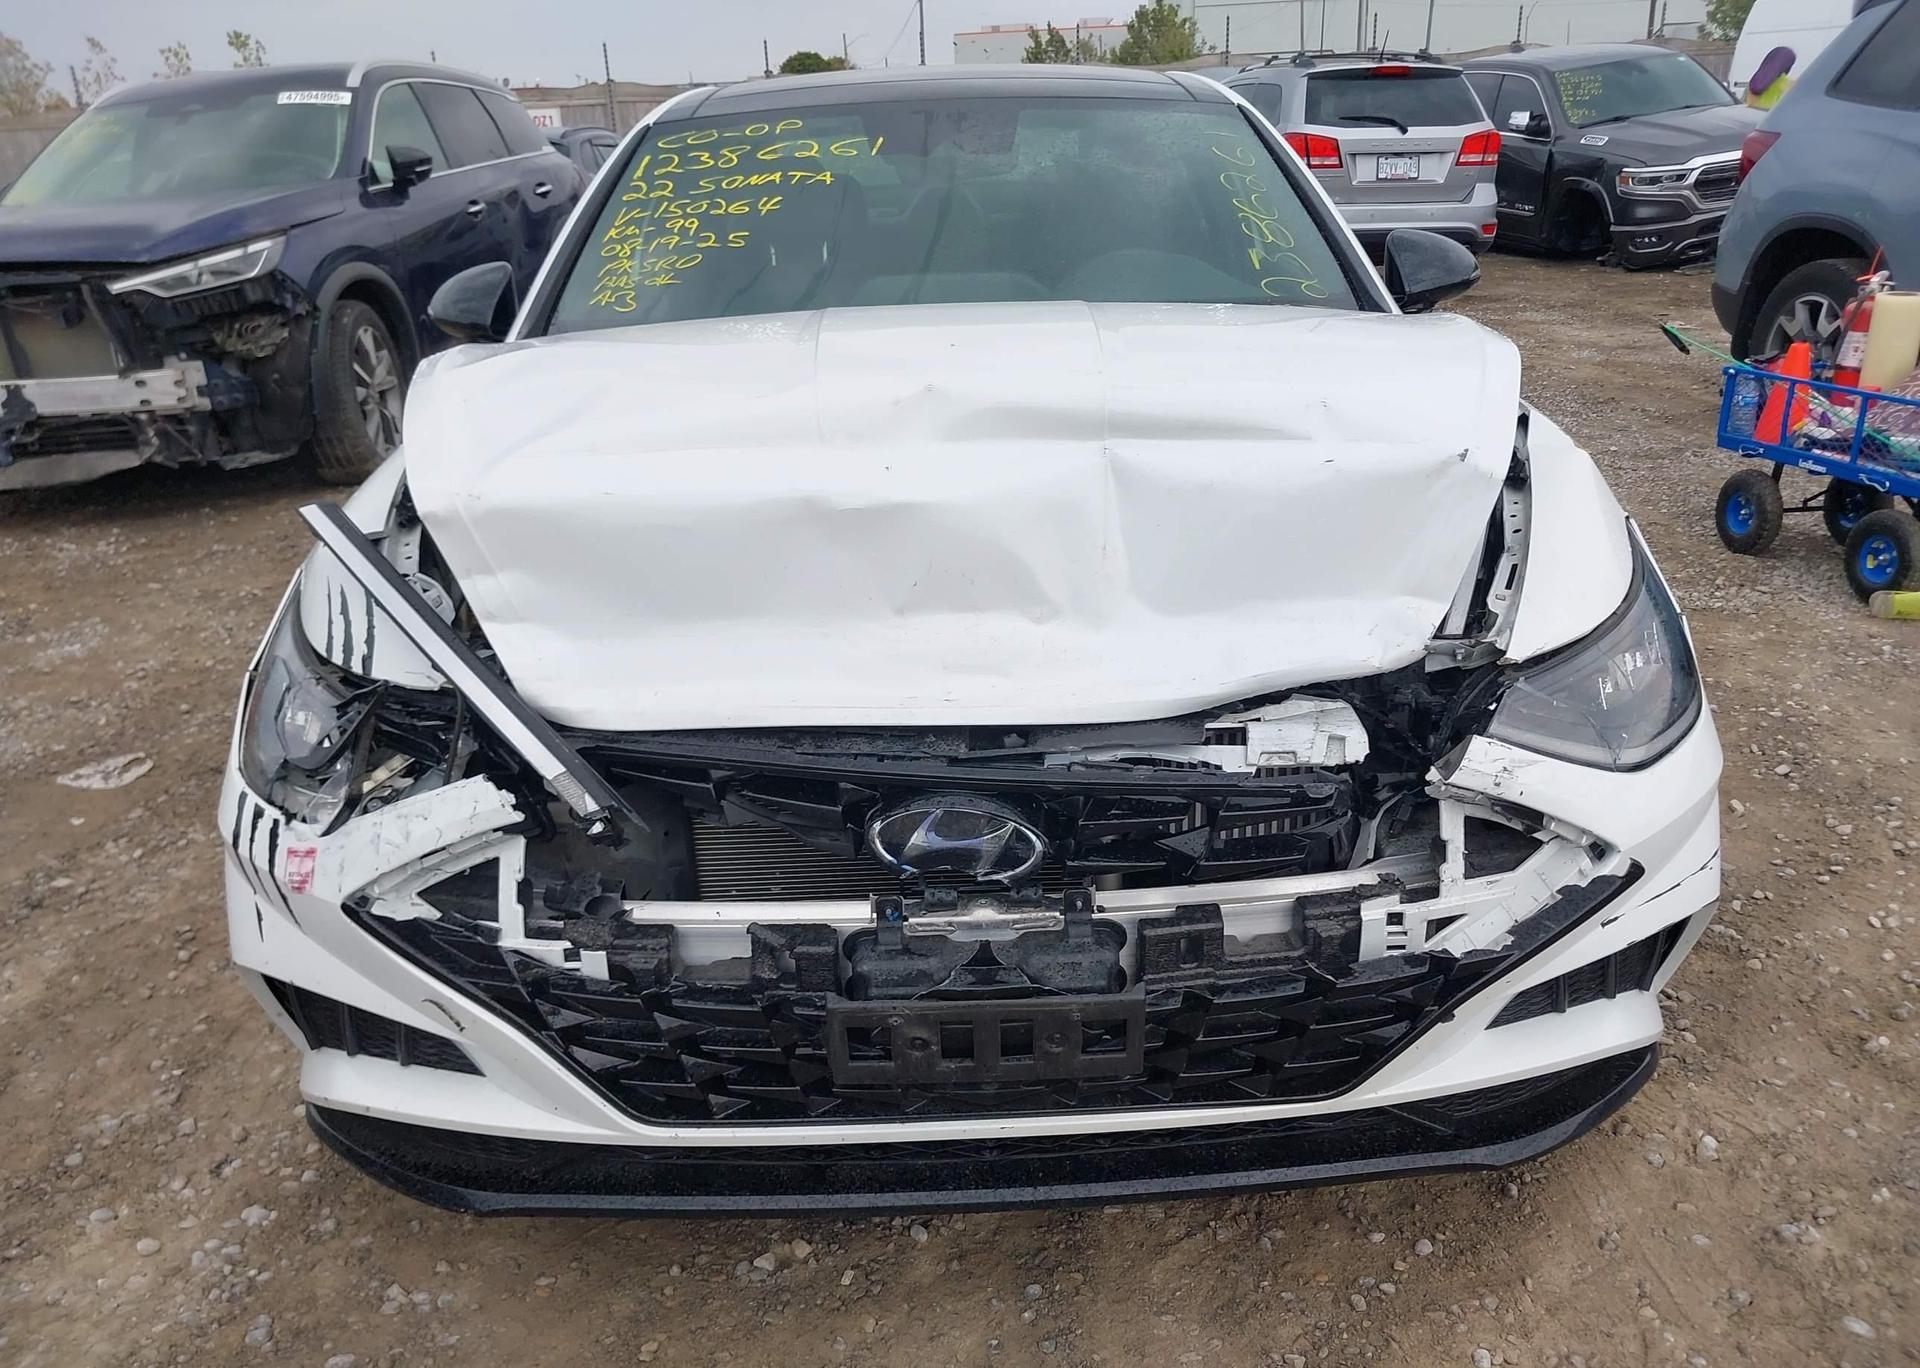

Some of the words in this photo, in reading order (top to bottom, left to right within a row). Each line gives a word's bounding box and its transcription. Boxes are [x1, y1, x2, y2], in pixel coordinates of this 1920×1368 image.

[632, 136, 885, 180] 12386261
[621, 180, 675, 202] 22
[688, 171, 835, 195] SONATA
